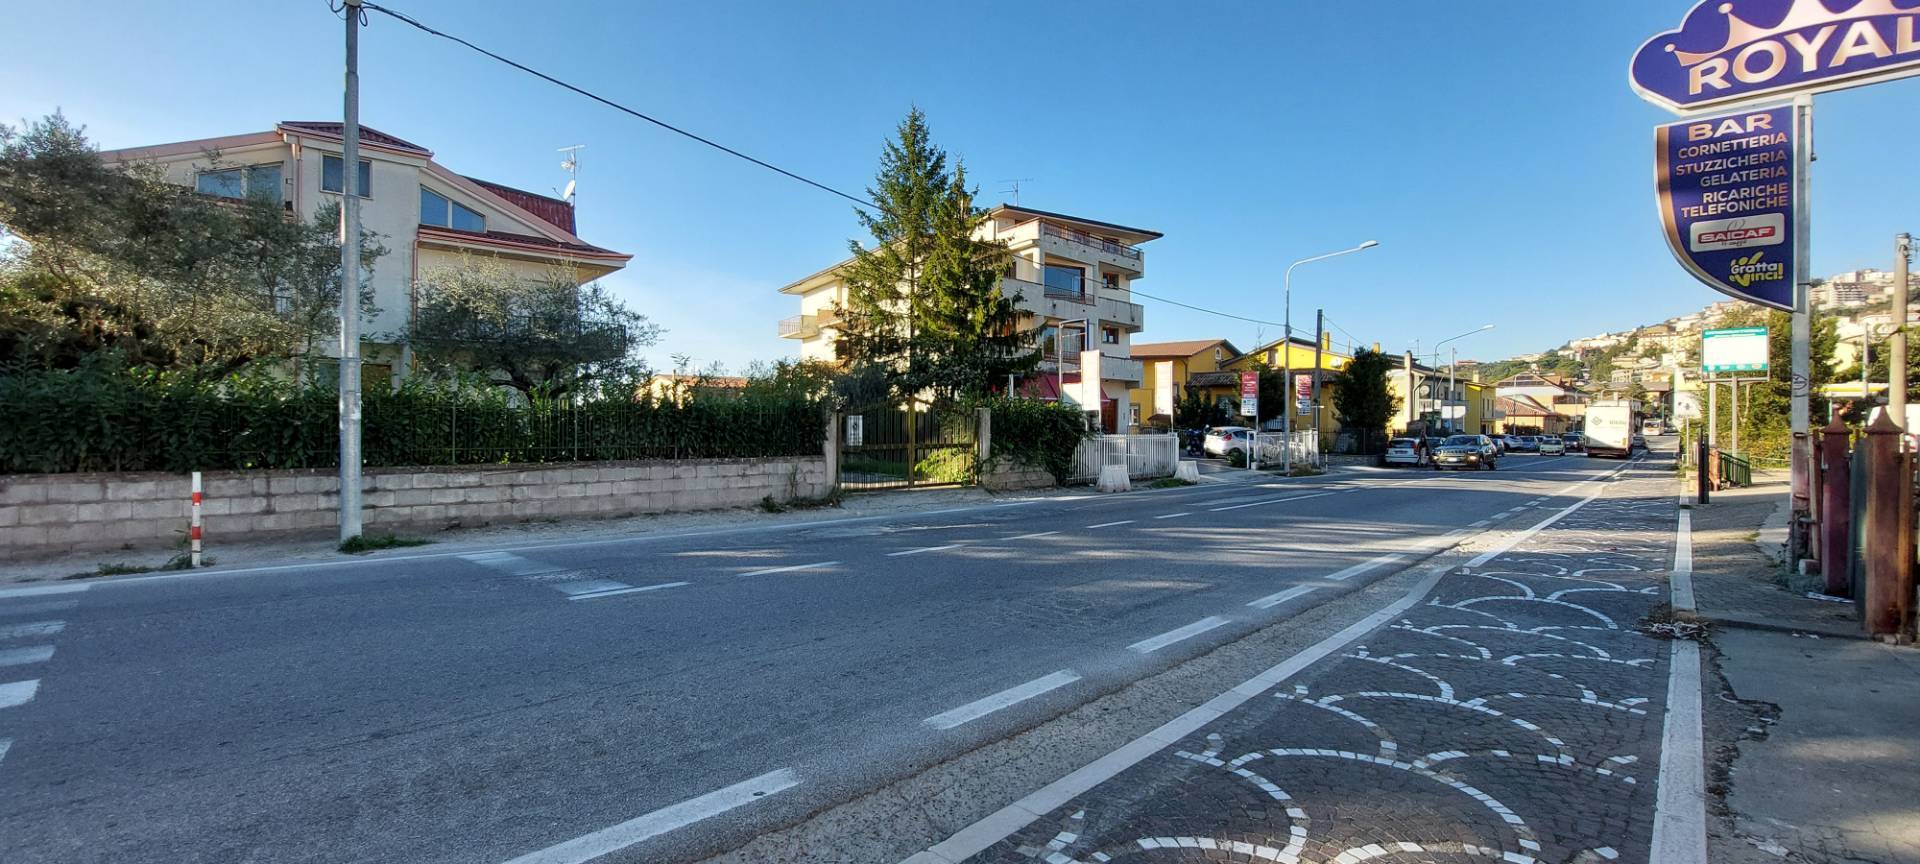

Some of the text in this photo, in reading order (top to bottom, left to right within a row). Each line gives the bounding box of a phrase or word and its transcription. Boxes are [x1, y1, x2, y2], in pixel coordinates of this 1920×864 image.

[1689, 16, 1920, 95] ROYAL
[1688, 113, 1773, 141] BAR
[1678, 132, 1788, 159] CORNETTERIA
[1675, 150, 1788, 176] STUZZICHERIA
[1700, 166, 1788, 187] GELATERIA
[1703, 182, 1788, 204] RICARICHE
[1681, 195, 1788, 218] TELEFONICHE
[1700, 228, 1772, 242] SAICAF
[1731, 262, 1778, 274] Gratta
